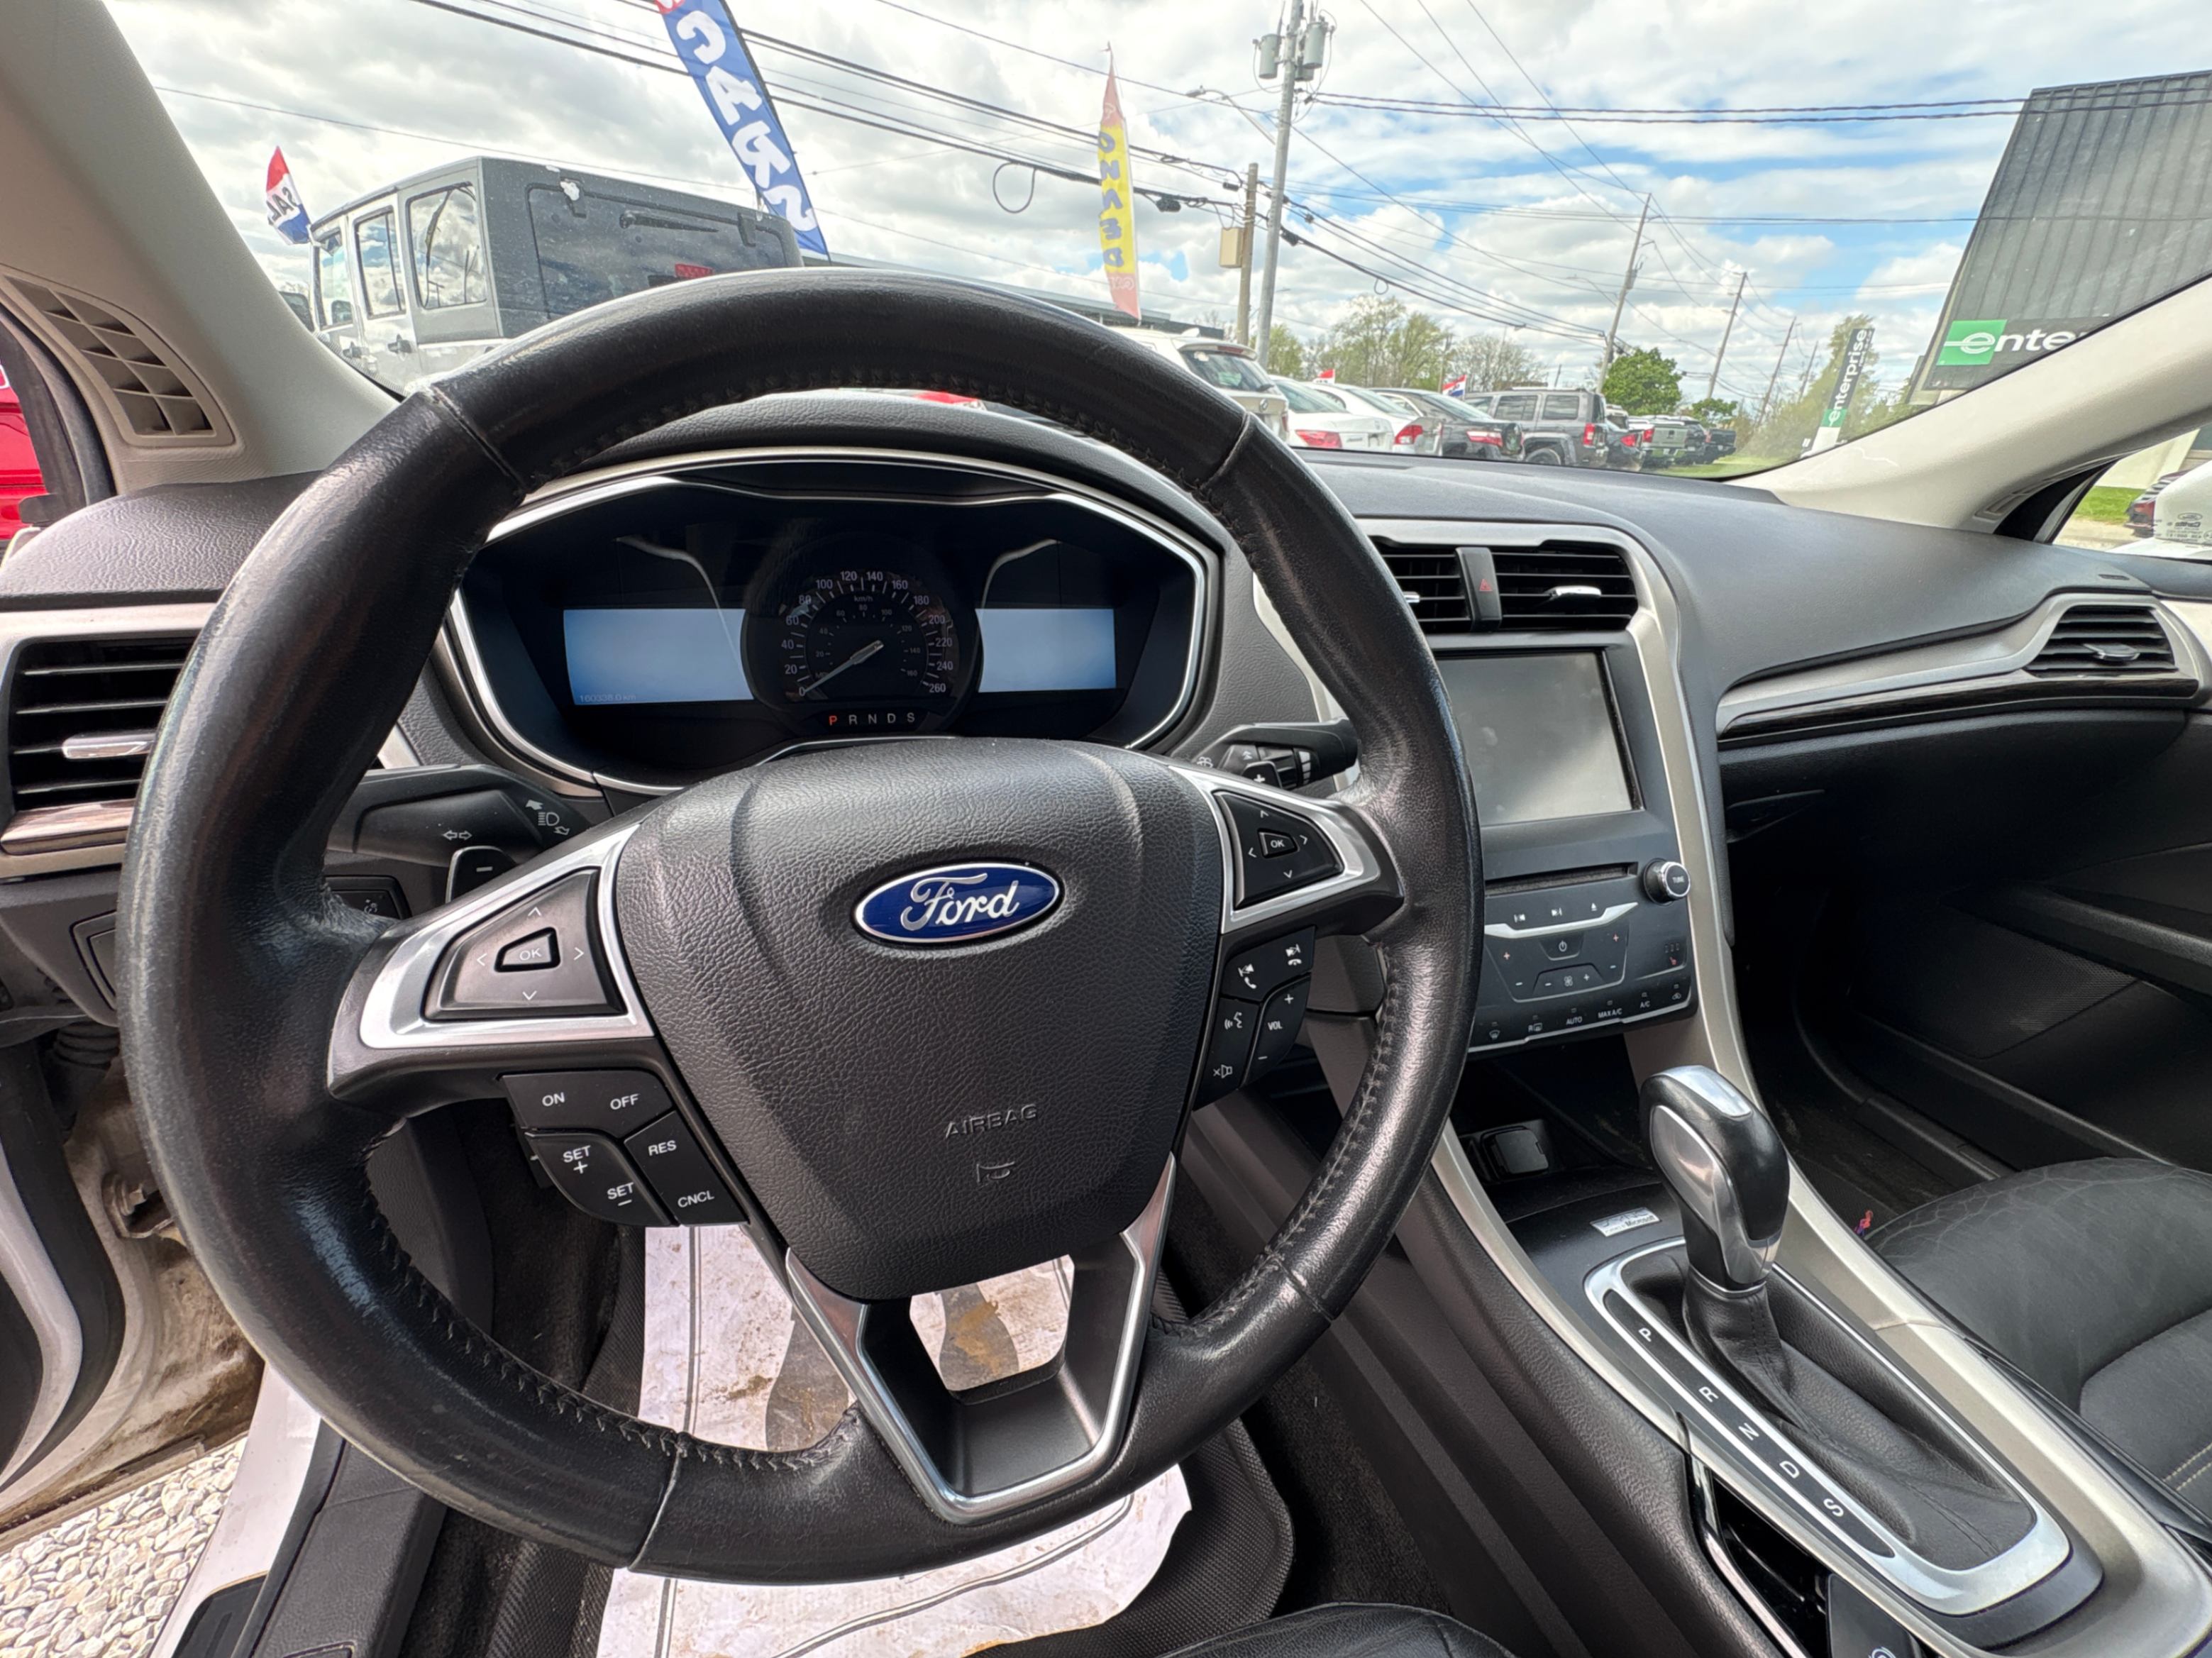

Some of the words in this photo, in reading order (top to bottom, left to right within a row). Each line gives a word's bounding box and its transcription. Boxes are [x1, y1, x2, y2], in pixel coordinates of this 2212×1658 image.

[1944, 322, 2087, 354] ente
[1828, 329, 1867, 426] enterprise
[840, 571, 858, 582] 120
[866, 571, 883, 582] 140
[816, 580, 833, 590] 100
[892, 580, 908, 590] 160
[914, 595, 929, 605] 180
[785, 615, 800, 625] 60
[929, 614, 945, 624] 200
[781, 639, 794, 650] 40
[936, 637, 952, 647] 220
[785, 664, 797, 675] 20
[936, 661, 953, 670] 240
[799, 686, 805, 697] 0
[929, 682, 946, 693] 260
[829, 716, 838, 726] P
[849, 715, 858, 725] R
[868, 714, 877, 724] N
[887, 713, 896, 723] D
[907, 712, 915, 722] S
[1270, 839, 1285, 849] OK
[900, 873, 1019, 931] Ford
[519, 947, 541, 961] OK
[1639, 1000, 1650, 1009] A/C
[1598, 1009, 1611, 1019] MAX
[1611, 1007, 1622, 1017] A/C
[1267, 1020, 1283, 1031] VOL
[1566, 1016, 1583, 1026] AUTO
[542, 1093, 565, 1107] ON
[610, 1094, 639, 1110] OFF
[946, 1105, 1037, 1138] AIRBAG
[648, 1139, 677, 1156] RES
[563, 1145, 591, 1163] SET
[607, 1183, 634, 1200] SET
[677, 1190, 715, 1207] CNCL
[1638, 1327, 1652, 1342] P
[1698, 1386, 1719, 1403] R
[1738, 1422, 1760, 1442] N
[1779, 1460, 1801, 1479] D
[1823, 1497, 1845, 1518] S
